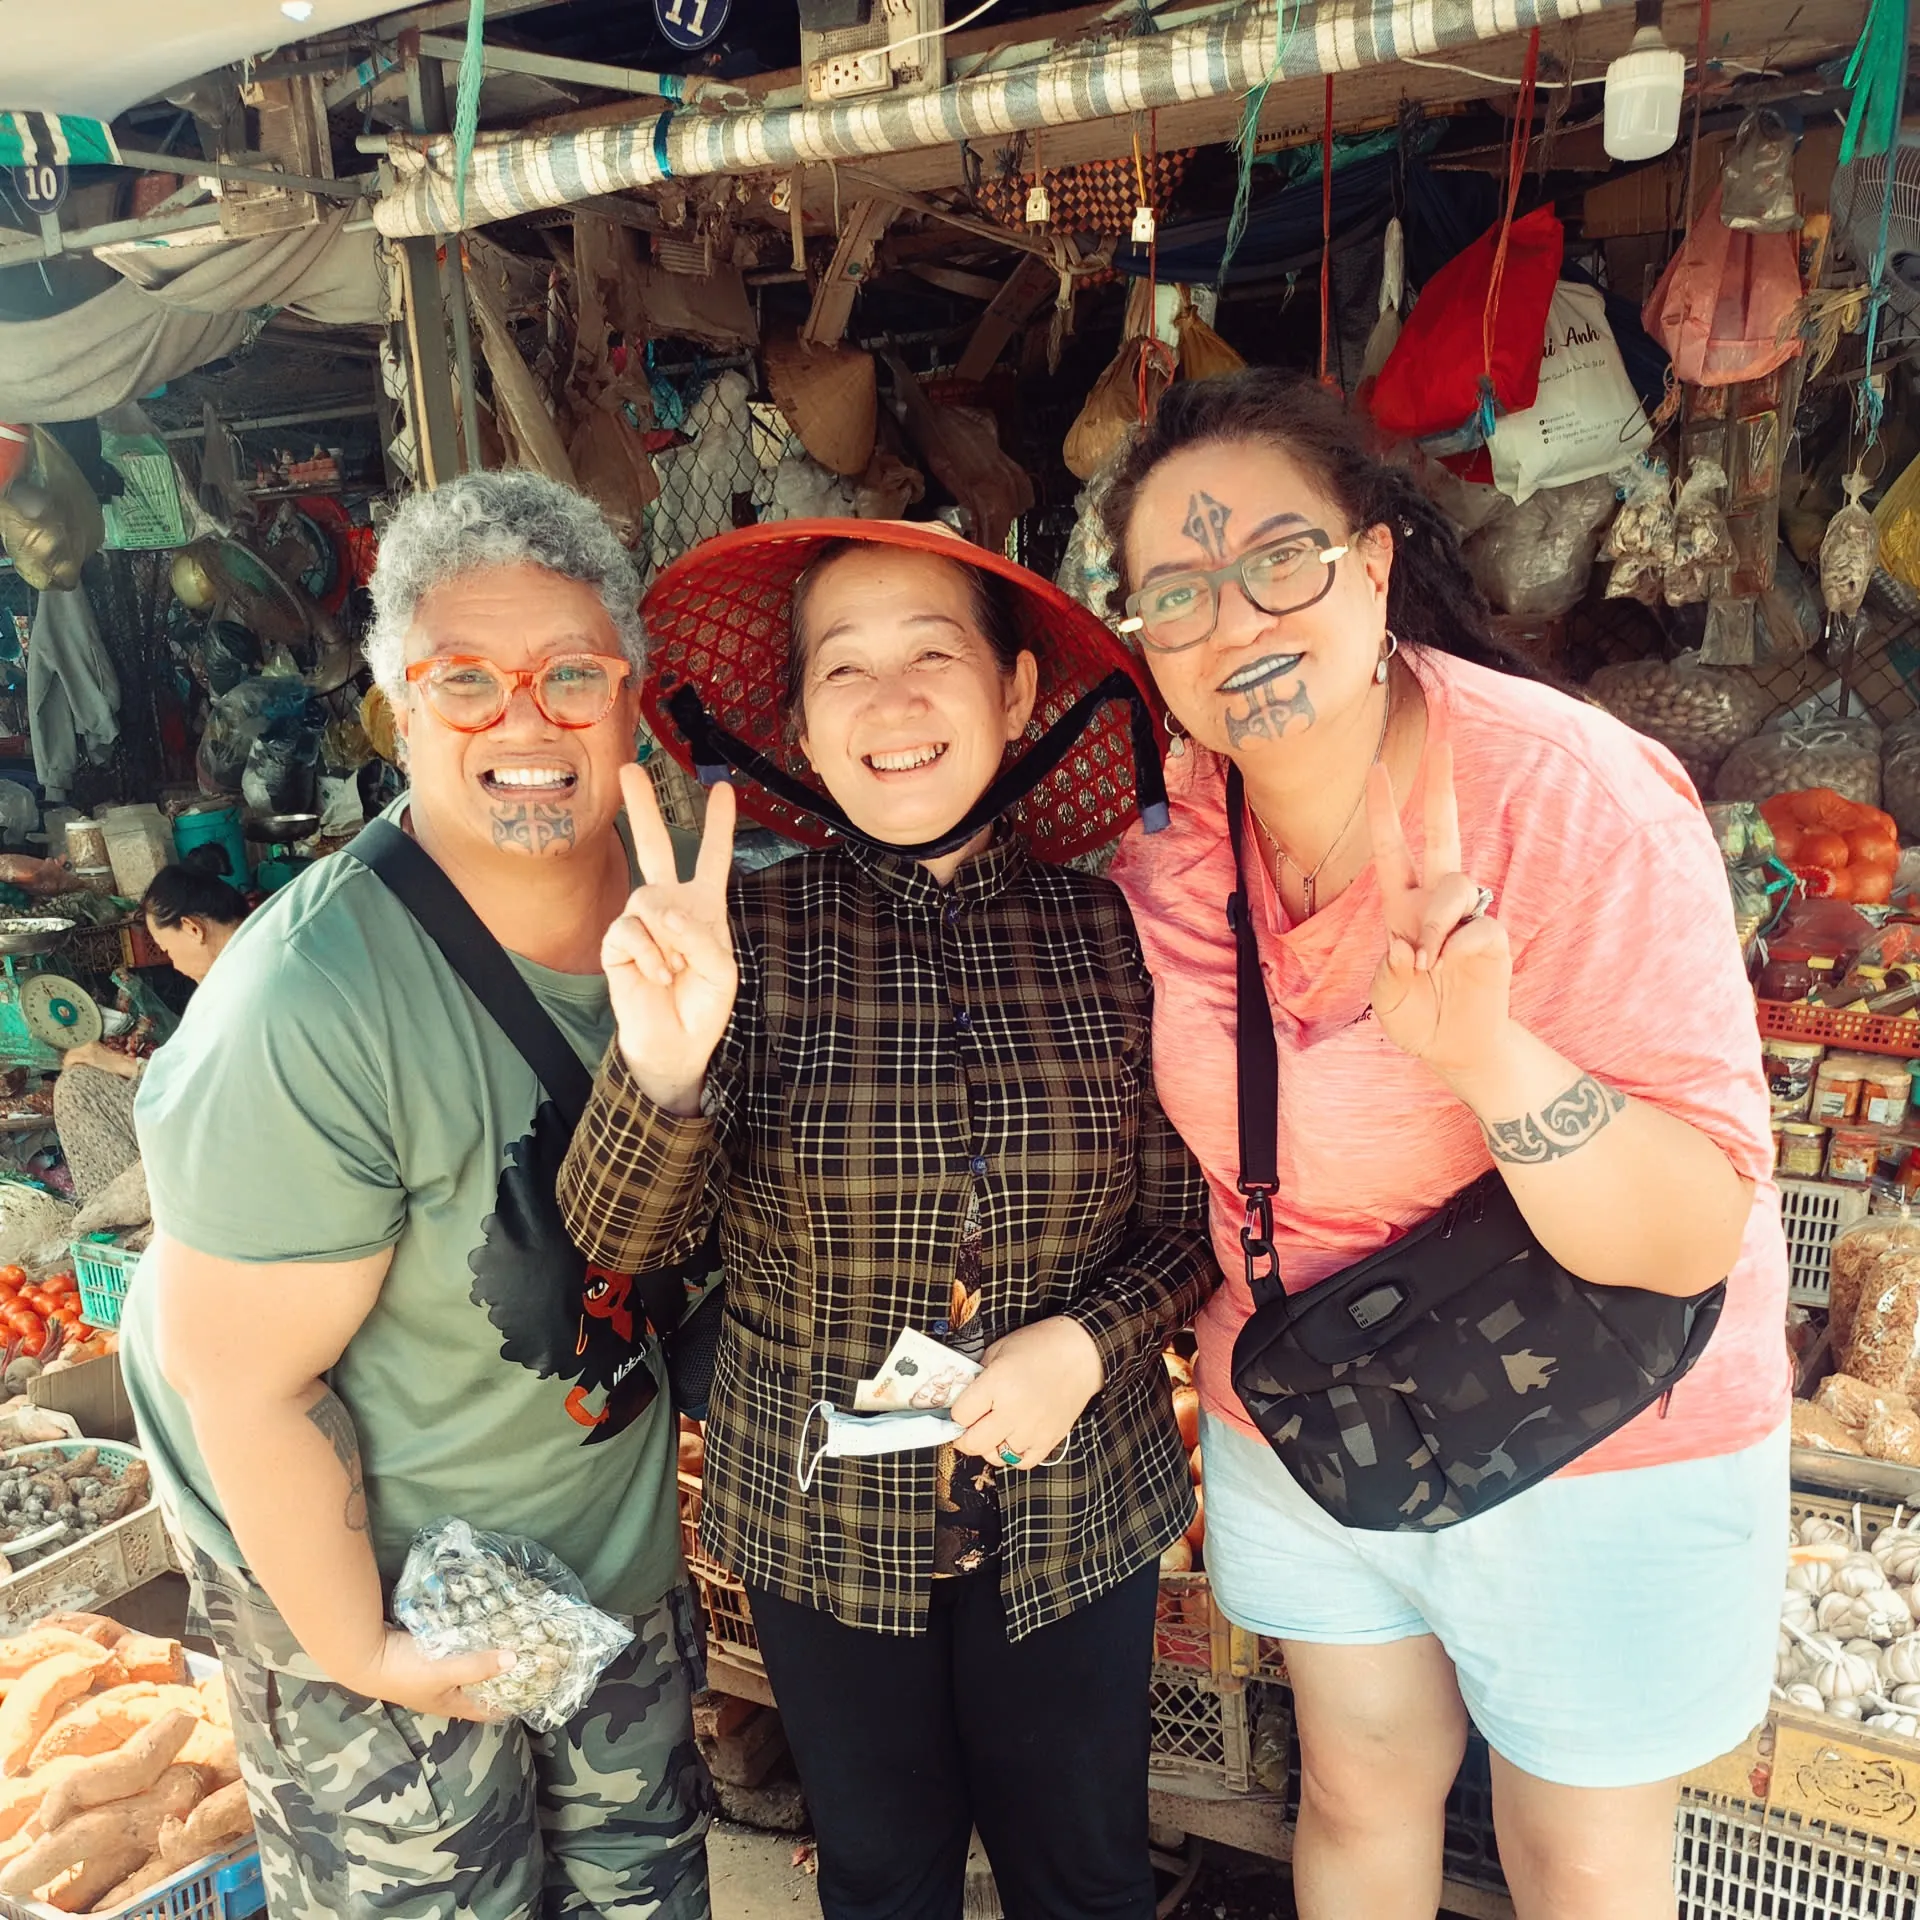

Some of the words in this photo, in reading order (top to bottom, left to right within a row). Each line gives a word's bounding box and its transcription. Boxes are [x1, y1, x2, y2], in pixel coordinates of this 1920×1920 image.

[665, 0, 708, 37] 11
[25, 167, 57, 201] 10
[1560, 322, 1601, 347] Anh
